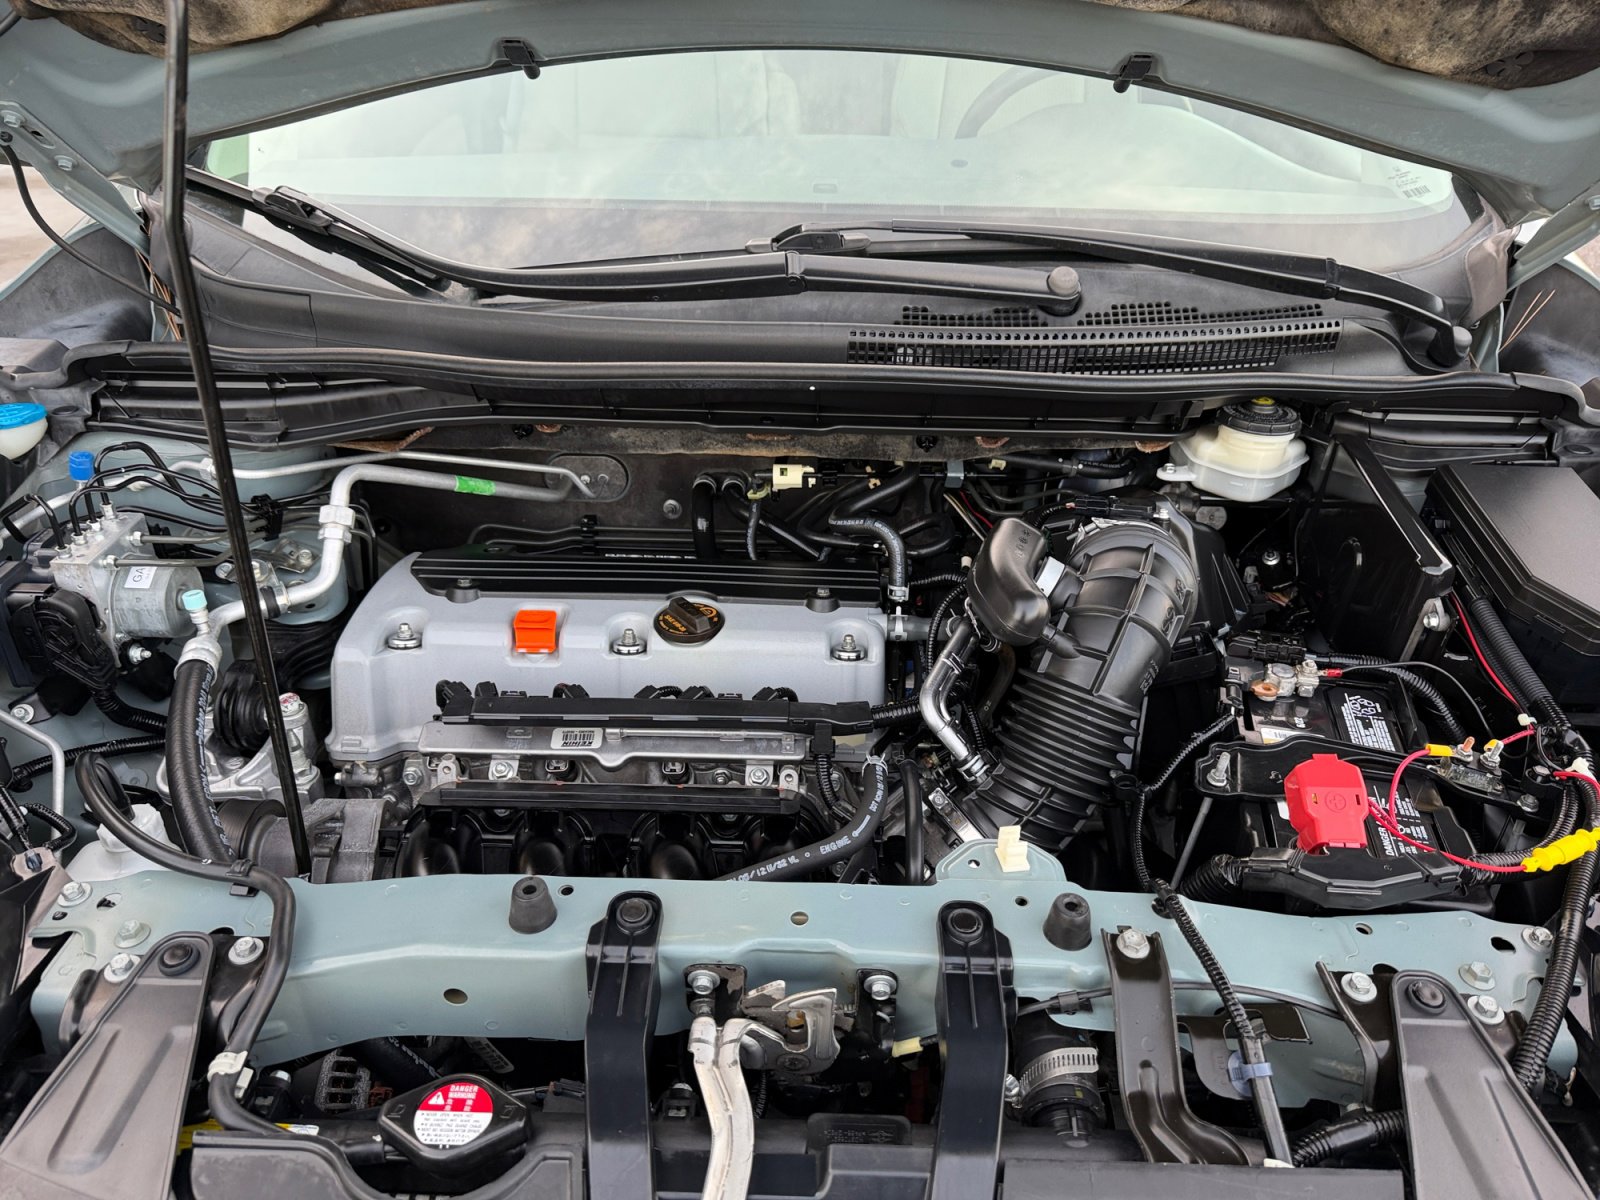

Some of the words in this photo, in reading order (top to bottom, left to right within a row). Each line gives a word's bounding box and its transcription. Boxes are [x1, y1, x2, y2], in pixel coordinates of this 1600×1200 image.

[819, 835, 851, 855] ENGINE
[1378, 826, 1395, 857] DANGER
[450, 1085, 479, 1093] DANGER
